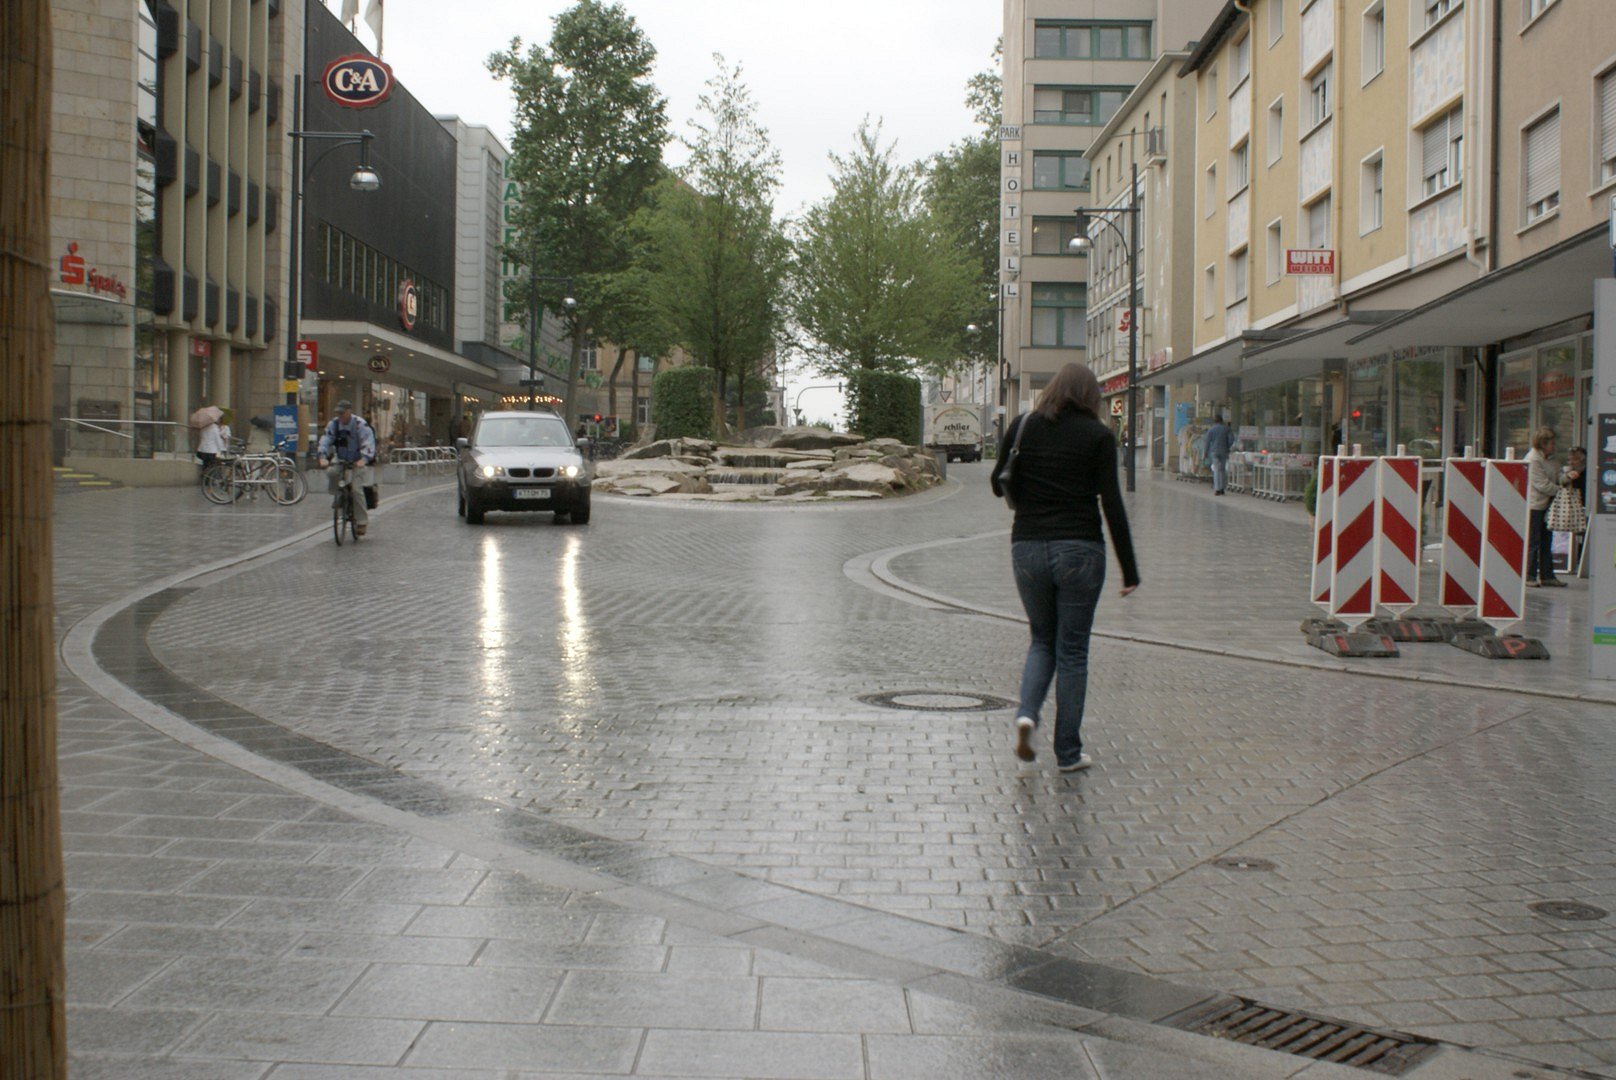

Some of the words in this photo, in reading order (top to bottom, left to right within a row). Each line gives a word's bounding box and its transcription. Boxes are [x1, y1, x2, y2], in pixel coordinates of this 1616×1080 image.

[335, 68, 380, 92] C&A
[1000, 126, 1020, 139] PARK
[1290, 251, 1332, 265] WITT
[1291, 265, 1331, 273] WEIDEN
